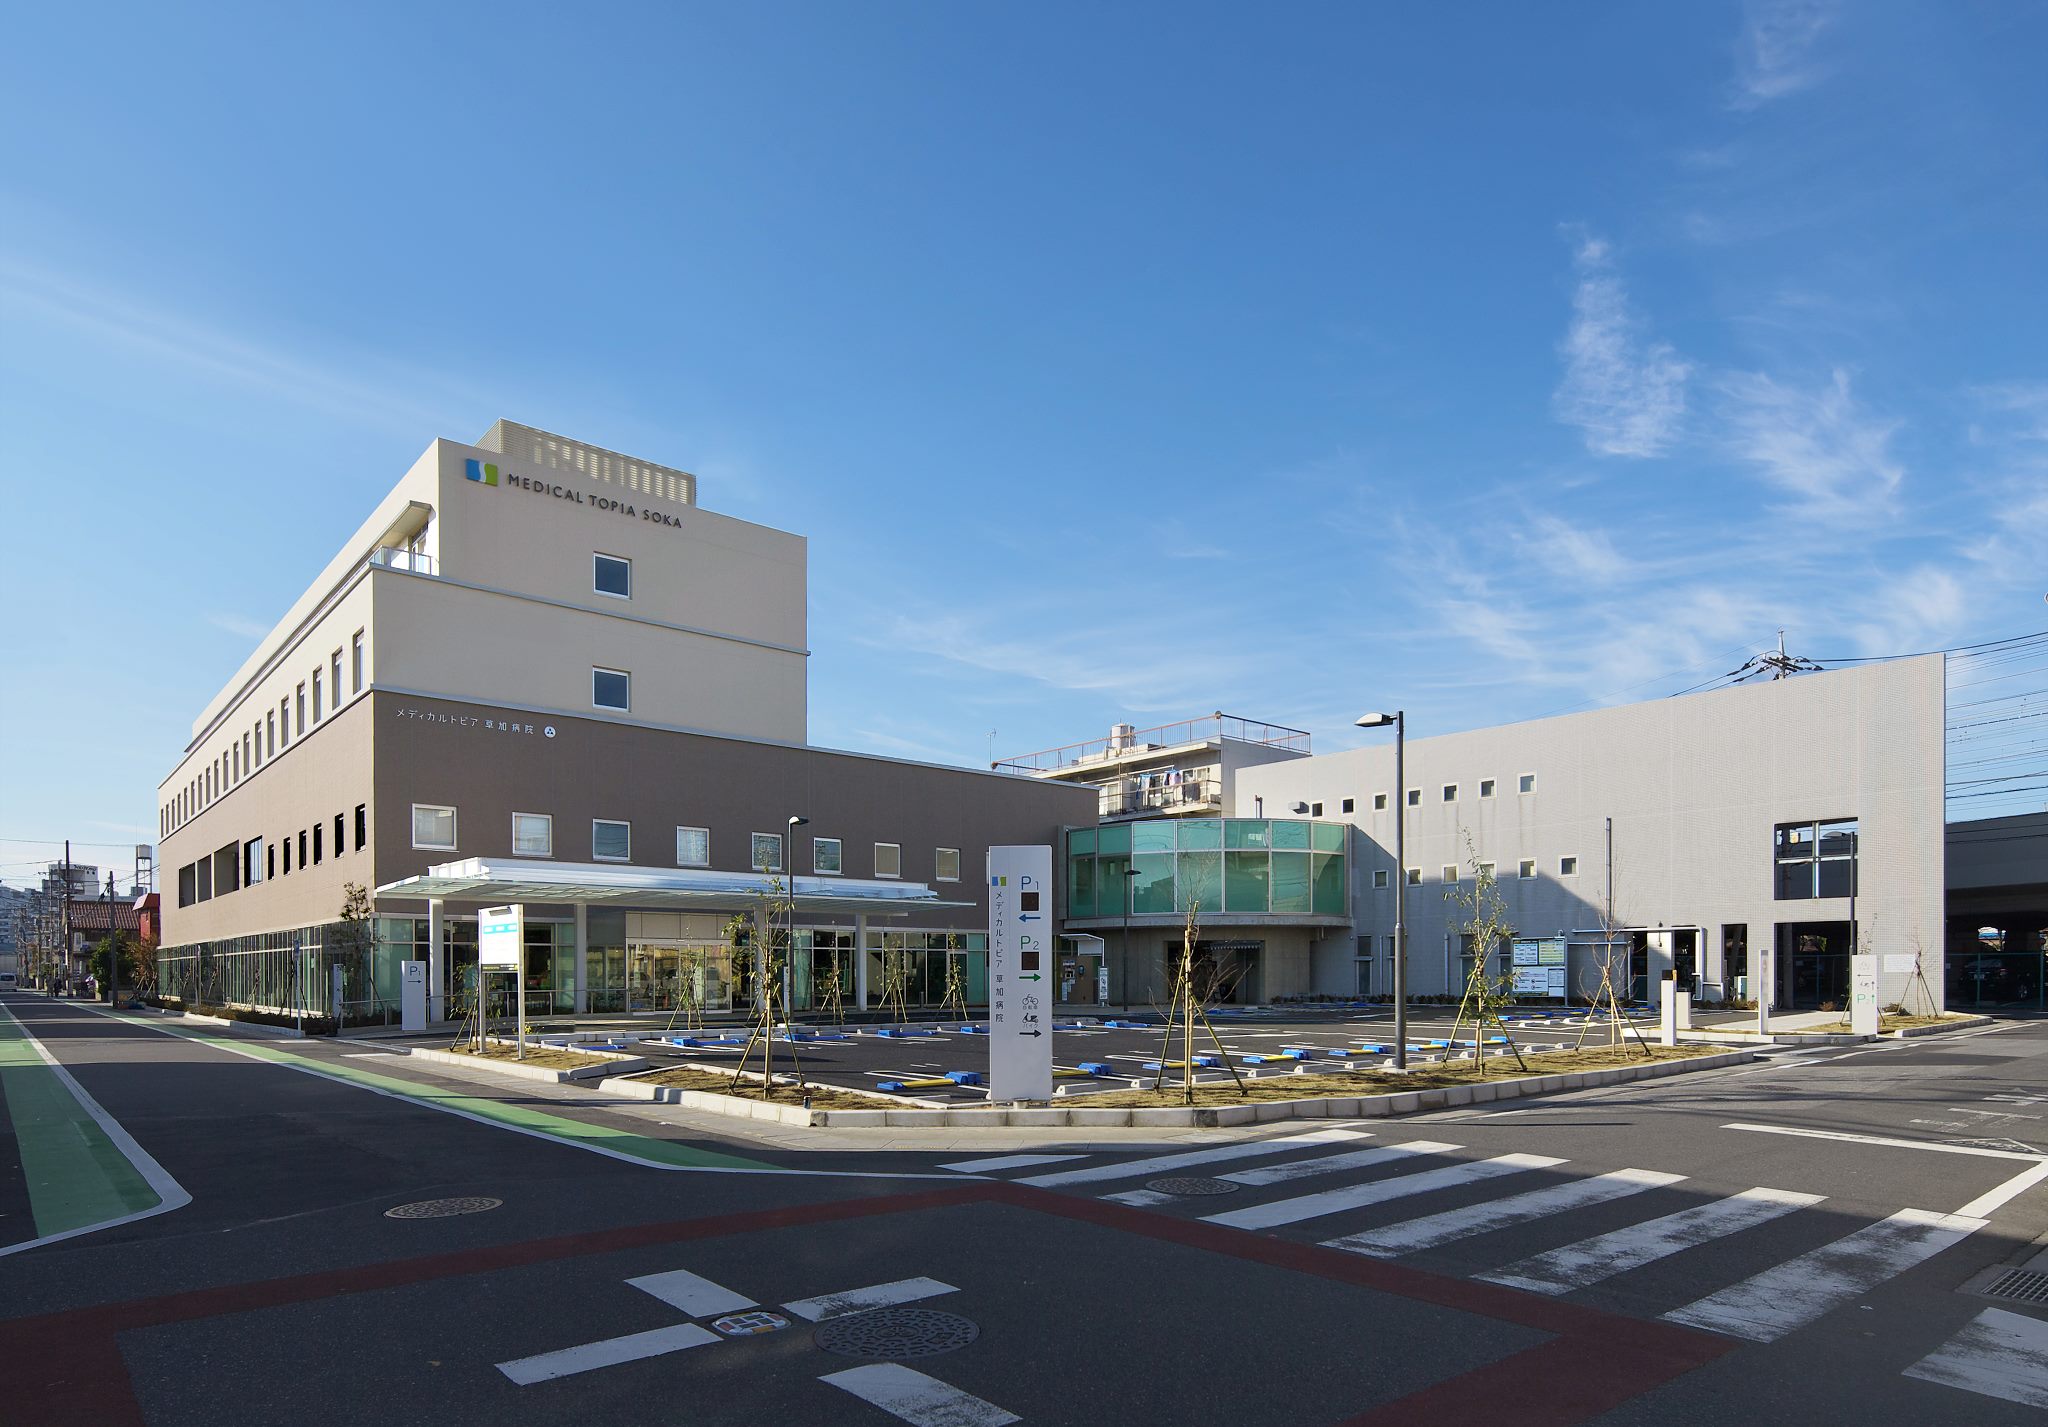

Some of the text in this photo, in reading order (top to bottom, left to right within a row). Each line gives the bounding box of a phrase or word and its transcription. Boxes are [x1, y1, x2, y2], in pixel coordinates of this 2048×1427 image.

[508, 473, 683, 529] MEDICAL TOPIA SOKA
